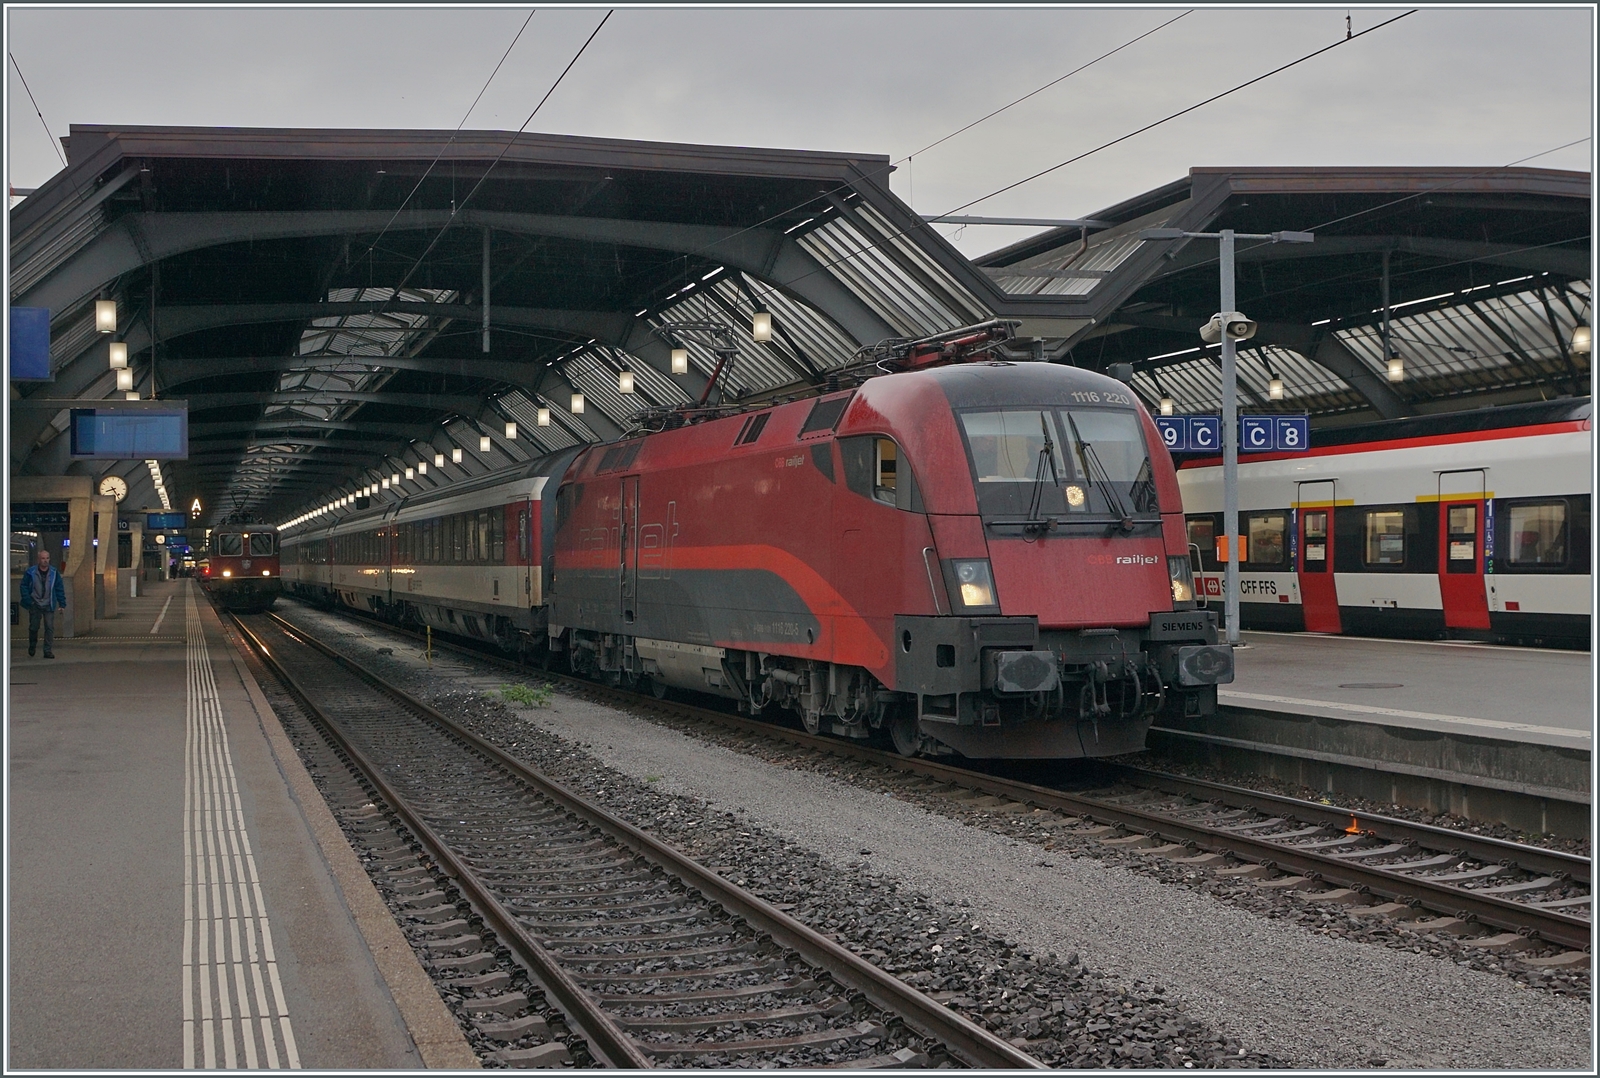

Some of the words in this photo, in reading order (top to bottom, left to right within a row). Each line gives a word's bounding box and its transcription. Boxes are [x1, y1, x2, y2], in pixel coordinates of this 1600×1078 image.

[1071, 391, 1100, 403] 1116
[1103, 392, 1130, 405] 220
[1164, 427, 1178, 446] 9
[1197, 427, 1212, 446] C
[1250, 427, 1266, 446] C
[1285, 427, 1299, 446] 8
[786, 454, 805, 468] railjet
[191, 498, 203, 512] A
[1486, 498, 1493, 517] 1
[1291, 508, 1297, 524] 1
[118, 521, 127, 529] 10
[1116, 554, 1159, 566] railjet
[1240, 580, 1257, 594] CFF
[1259, 580, 1277, 595] FFS
[1162, 621, 1203, 632] SIEMENS
